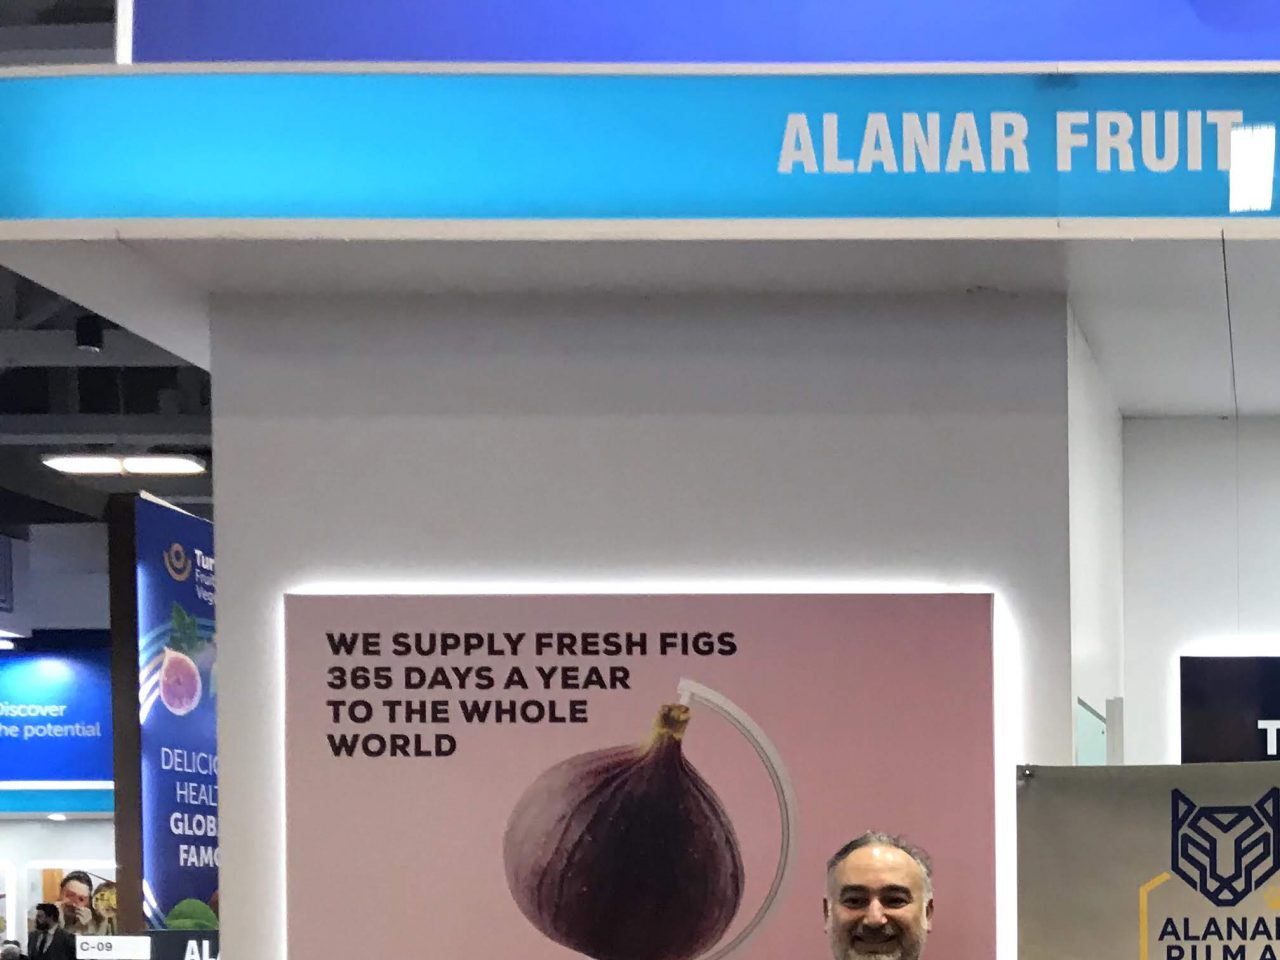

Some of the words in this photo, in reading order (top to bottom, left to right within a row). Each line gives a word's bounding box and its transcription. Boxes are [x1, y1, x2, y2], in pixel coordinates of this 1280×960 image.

[776, 111, 1031, 173] ALANAR
[1055, 109, 1244, 172] FRUIT
[325, 632, 382, 656] WE
[392, 632, 526, 656] SUPPLY
[536, 632, 648, 656] FRESH
[659, 632, 738, 656] FIGS
[326, 666, 394, 690] 365
[404, 666, 496, 690] DAYS
[503, 666, 529, 690] A
[536, 666, 632, 690] YEAR
[326, 700, 373, 724] TO
[382, 700, 450, 724] THE
[460, 699, 589, 724] WHOLE
[23, 721, 102, 740] potential
[326, 733, 458, 758] WORLD
[80, 942, 113, 952] C-09
